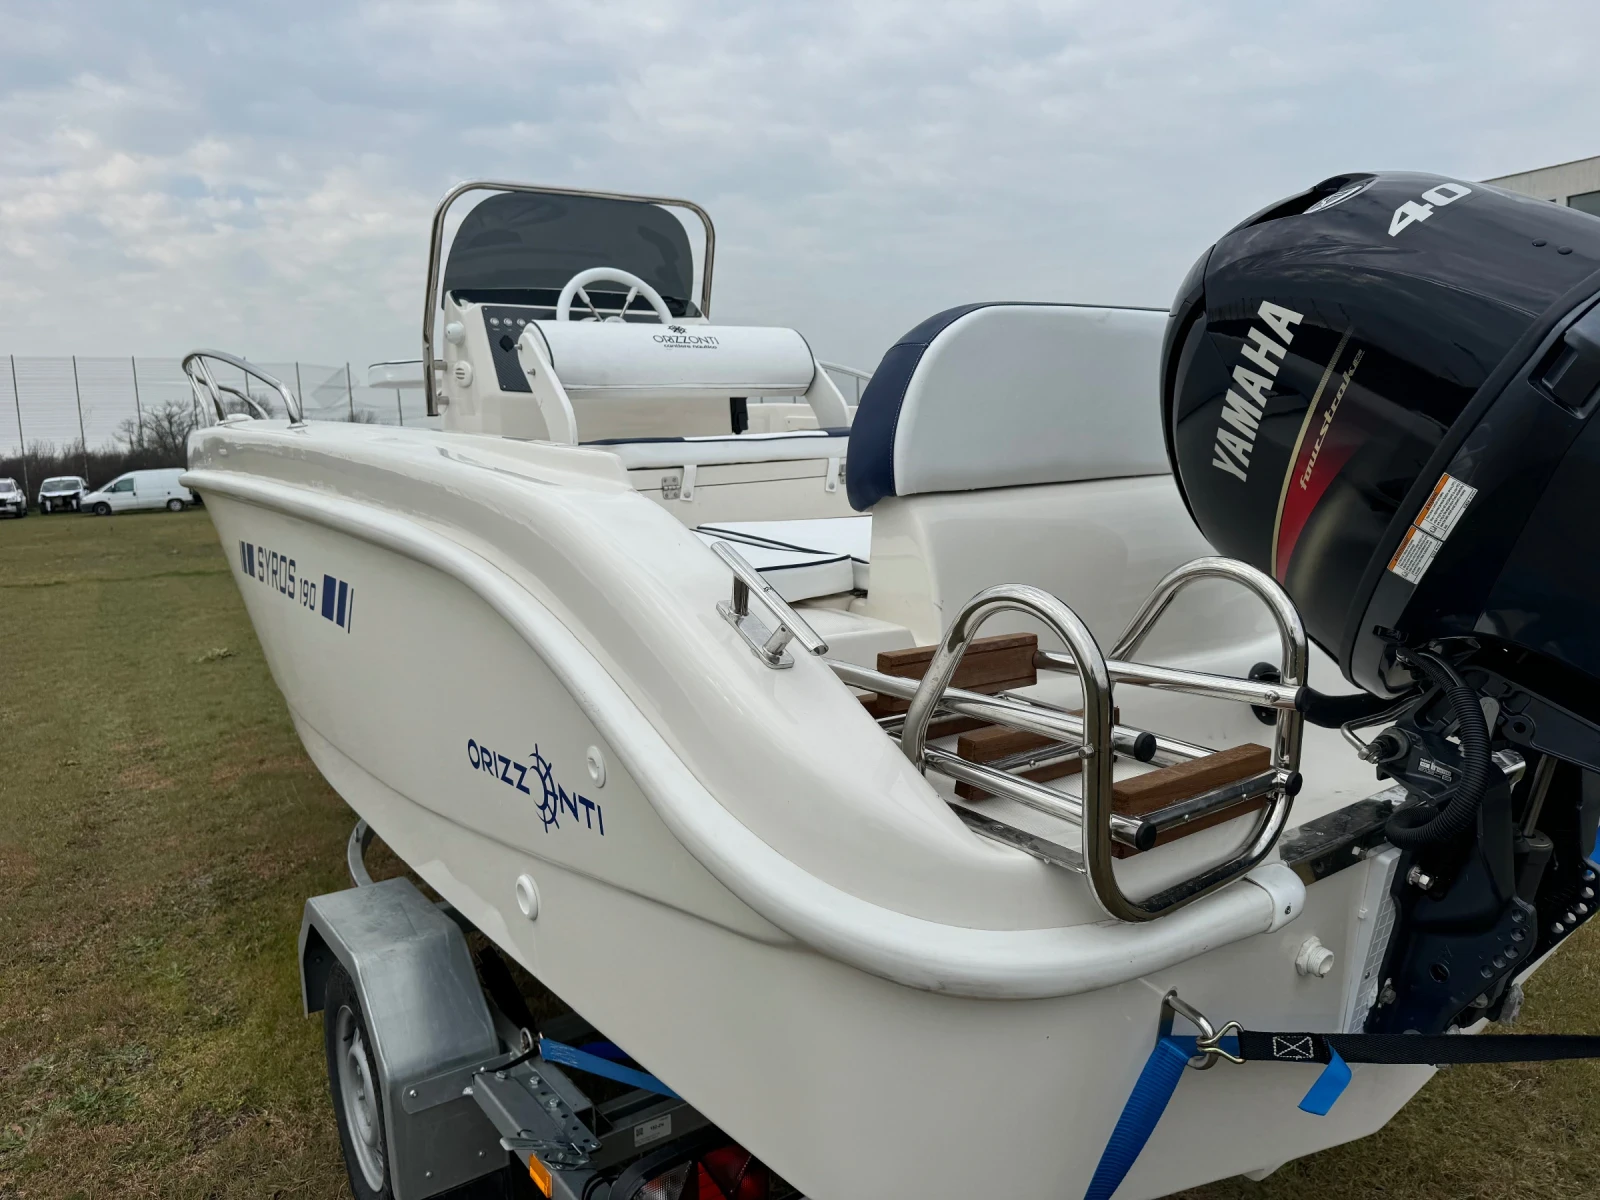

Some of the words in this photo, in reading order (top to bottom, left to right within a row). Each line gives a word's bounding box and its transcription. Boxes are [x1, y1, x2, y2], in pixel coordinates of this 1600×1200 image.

[1388, 182, 1472, 237] 40
[653, 335, 720, 344] ORIZZONTI
[1212, 300, 1304, 482] YAMAHA
[258, 546, 296, 600] SYROS
[300, 578, 316, 611] 190
[467, 738, 604, 836] ORIZZONTI
